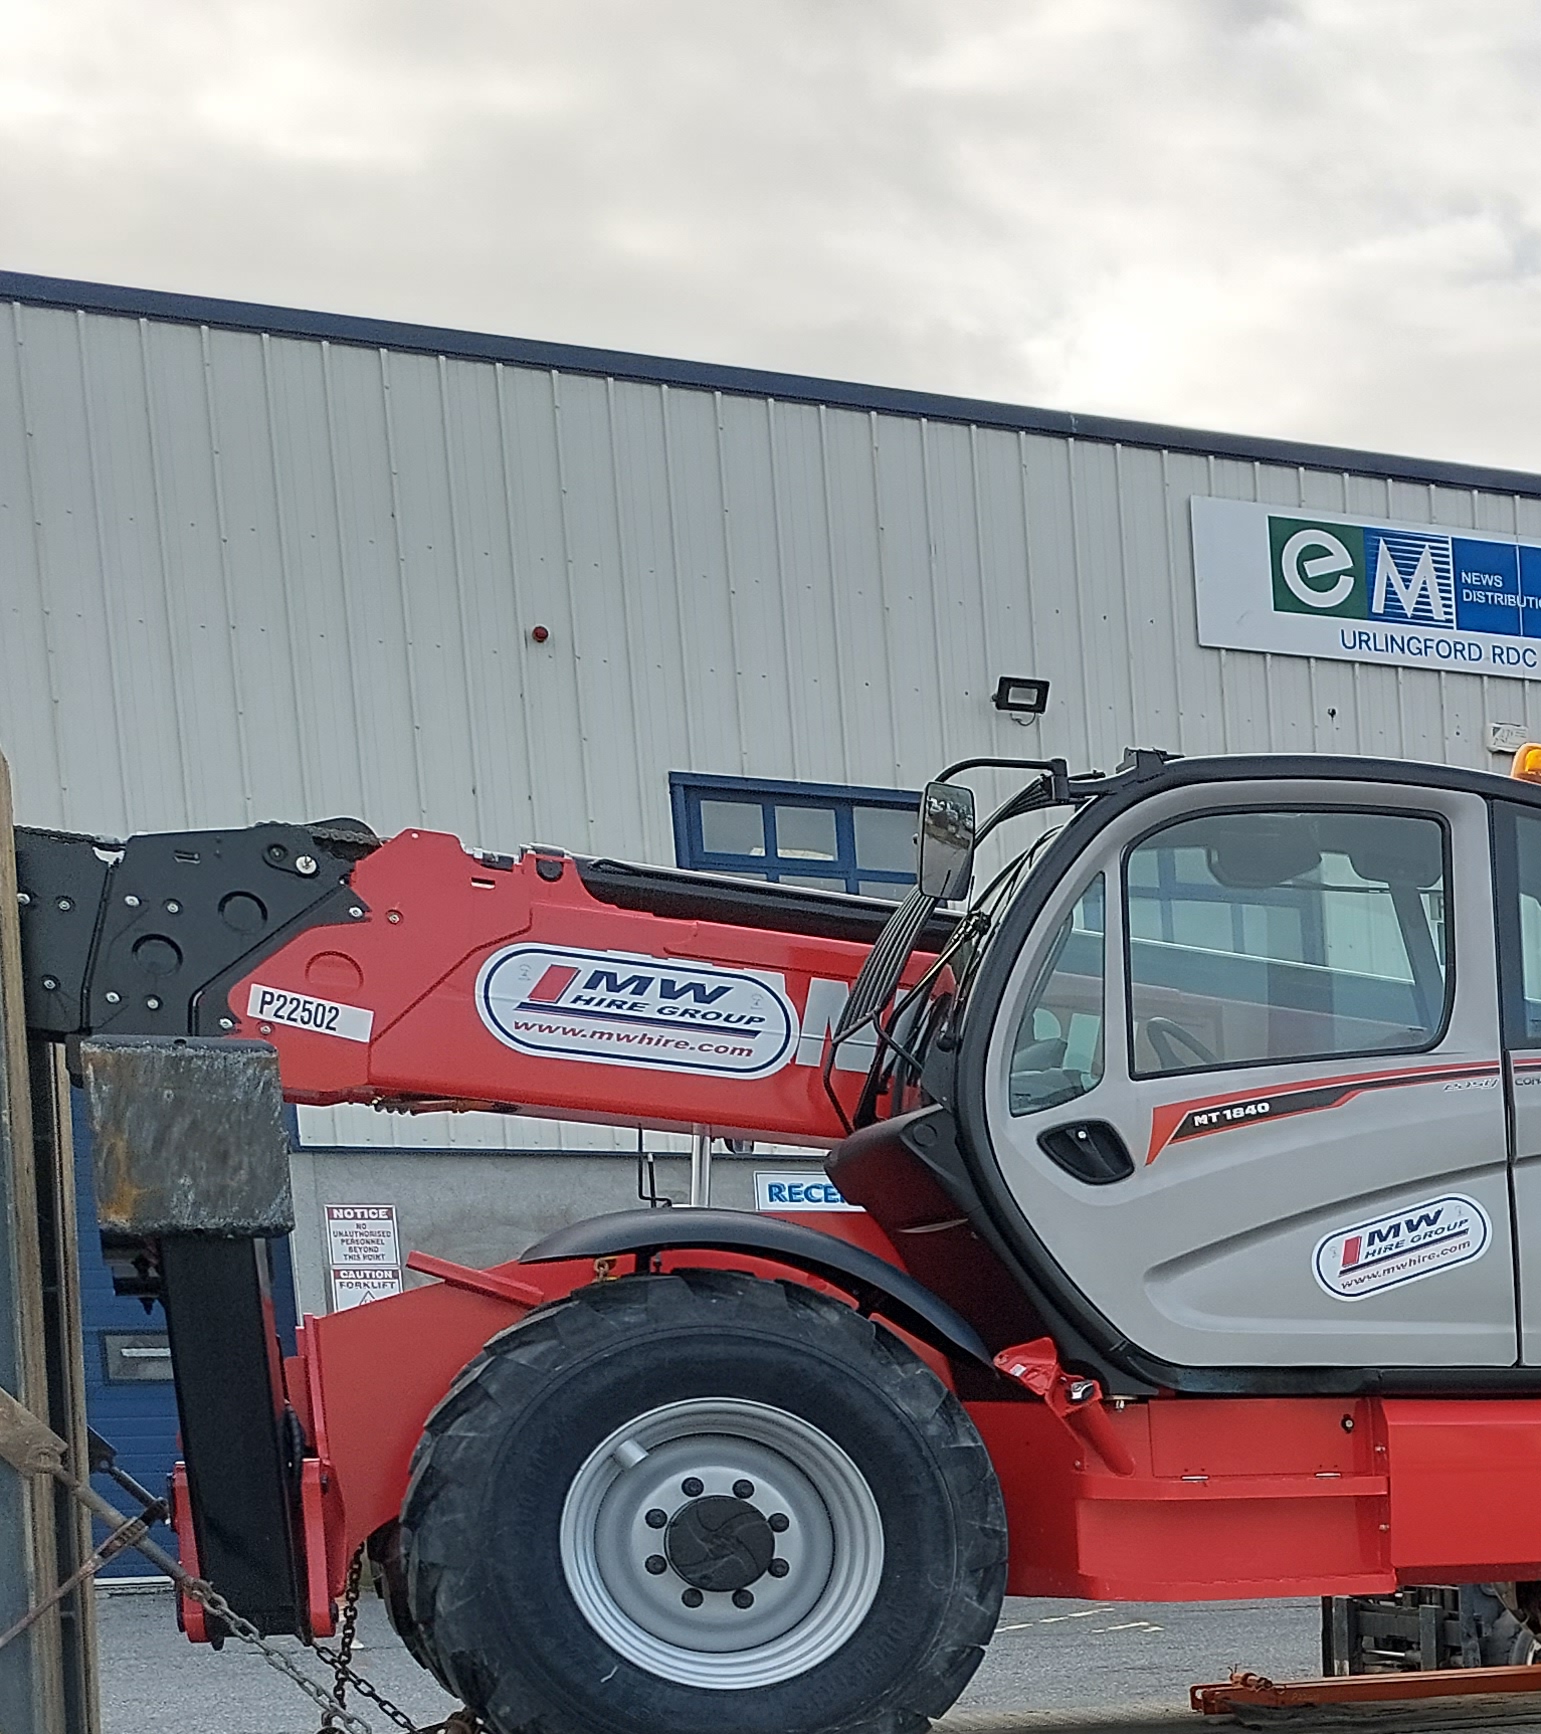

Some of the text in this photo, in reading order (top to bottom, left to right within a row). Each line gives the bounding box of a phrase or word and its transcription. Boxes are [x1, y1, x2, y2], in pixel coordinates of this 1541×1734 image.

[1461, 569, 1503, 588] NEWS
[1340, 629, 1538, 668] URLINGFORD RDC
[583, 968, 735, 1004] MW
[259, 990, 340, 1031] P22502
[569, 994, 766, 1026] HIRE GROUP
[513, 1019, 755, 1058] www.mwhire.com
[1193, 1102, 1270, 1127] MT 1840
[333, 1208, 389, 1219] NOTICE
[1366, 1207, 1444, 1248] MW
[348, 1246, 380, 1254] BEYOND
[1364, 1218, 1470, 1260] HIRE GROUP
[340, 1270, 393, 1279] CAUTION
[1340, 1240, 1471, 1290] www.mwhire.com
[339, 1281, 396, 1290] FORKLIFT
